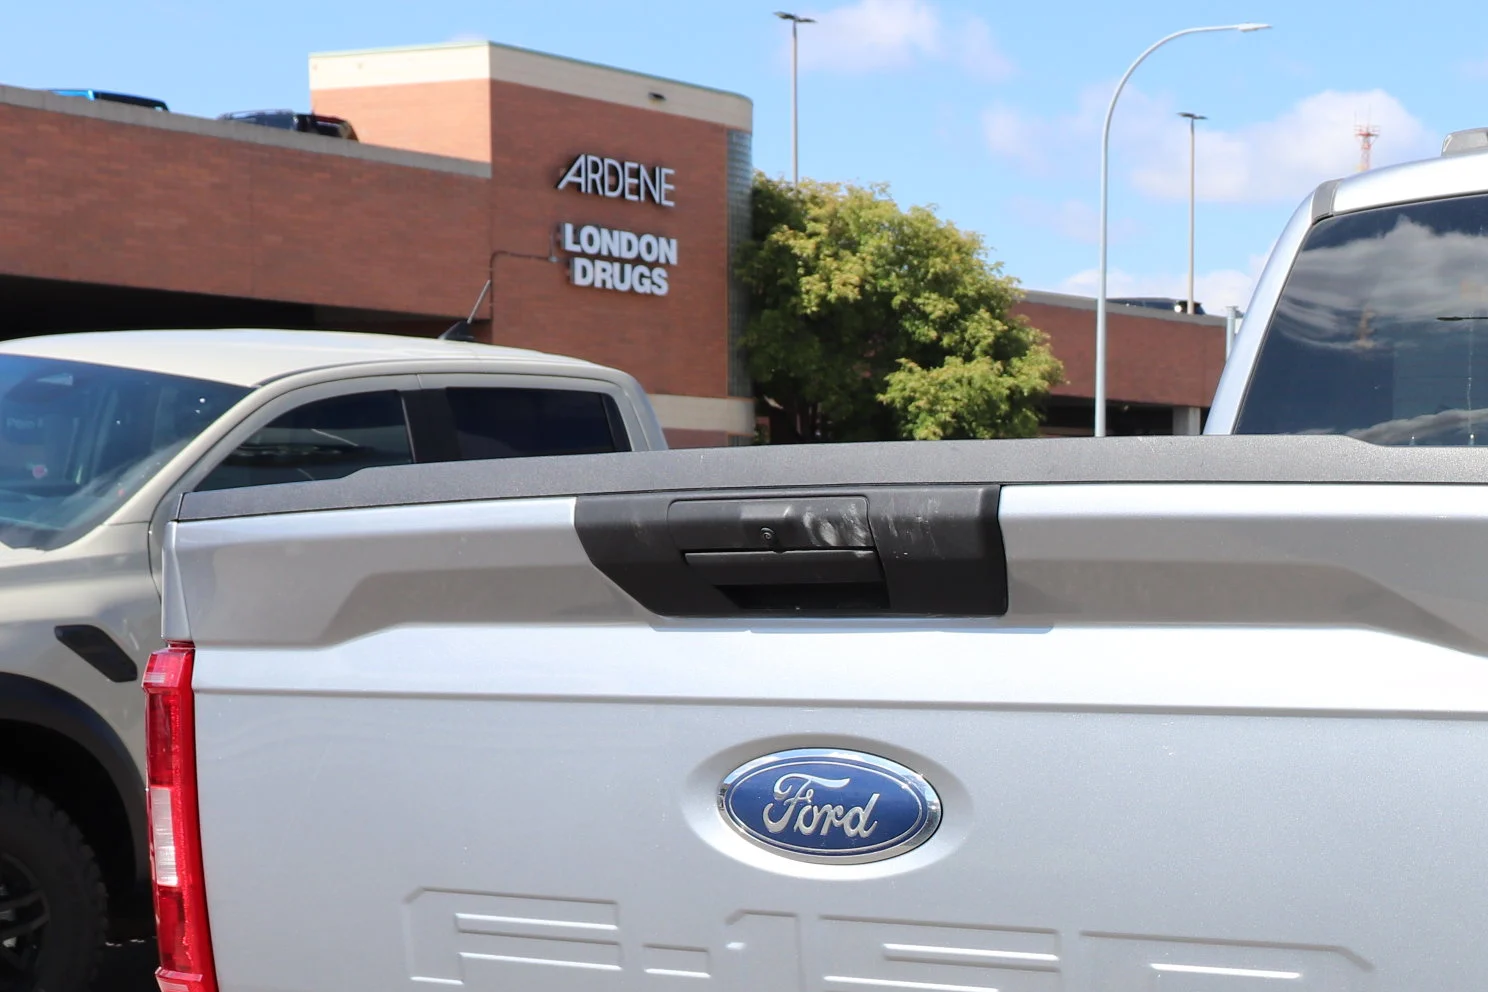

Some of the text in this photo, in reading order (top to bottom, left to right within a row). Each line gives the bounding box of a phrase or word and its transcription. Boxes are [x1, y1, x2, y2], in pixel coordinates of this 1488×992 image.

[557, 153, 676, 207] ARDENE
[564, 223, 677, 265] LONDON
[573, 257, 669, 295] DRUGS
[762, 772, 881, 838] Ford
